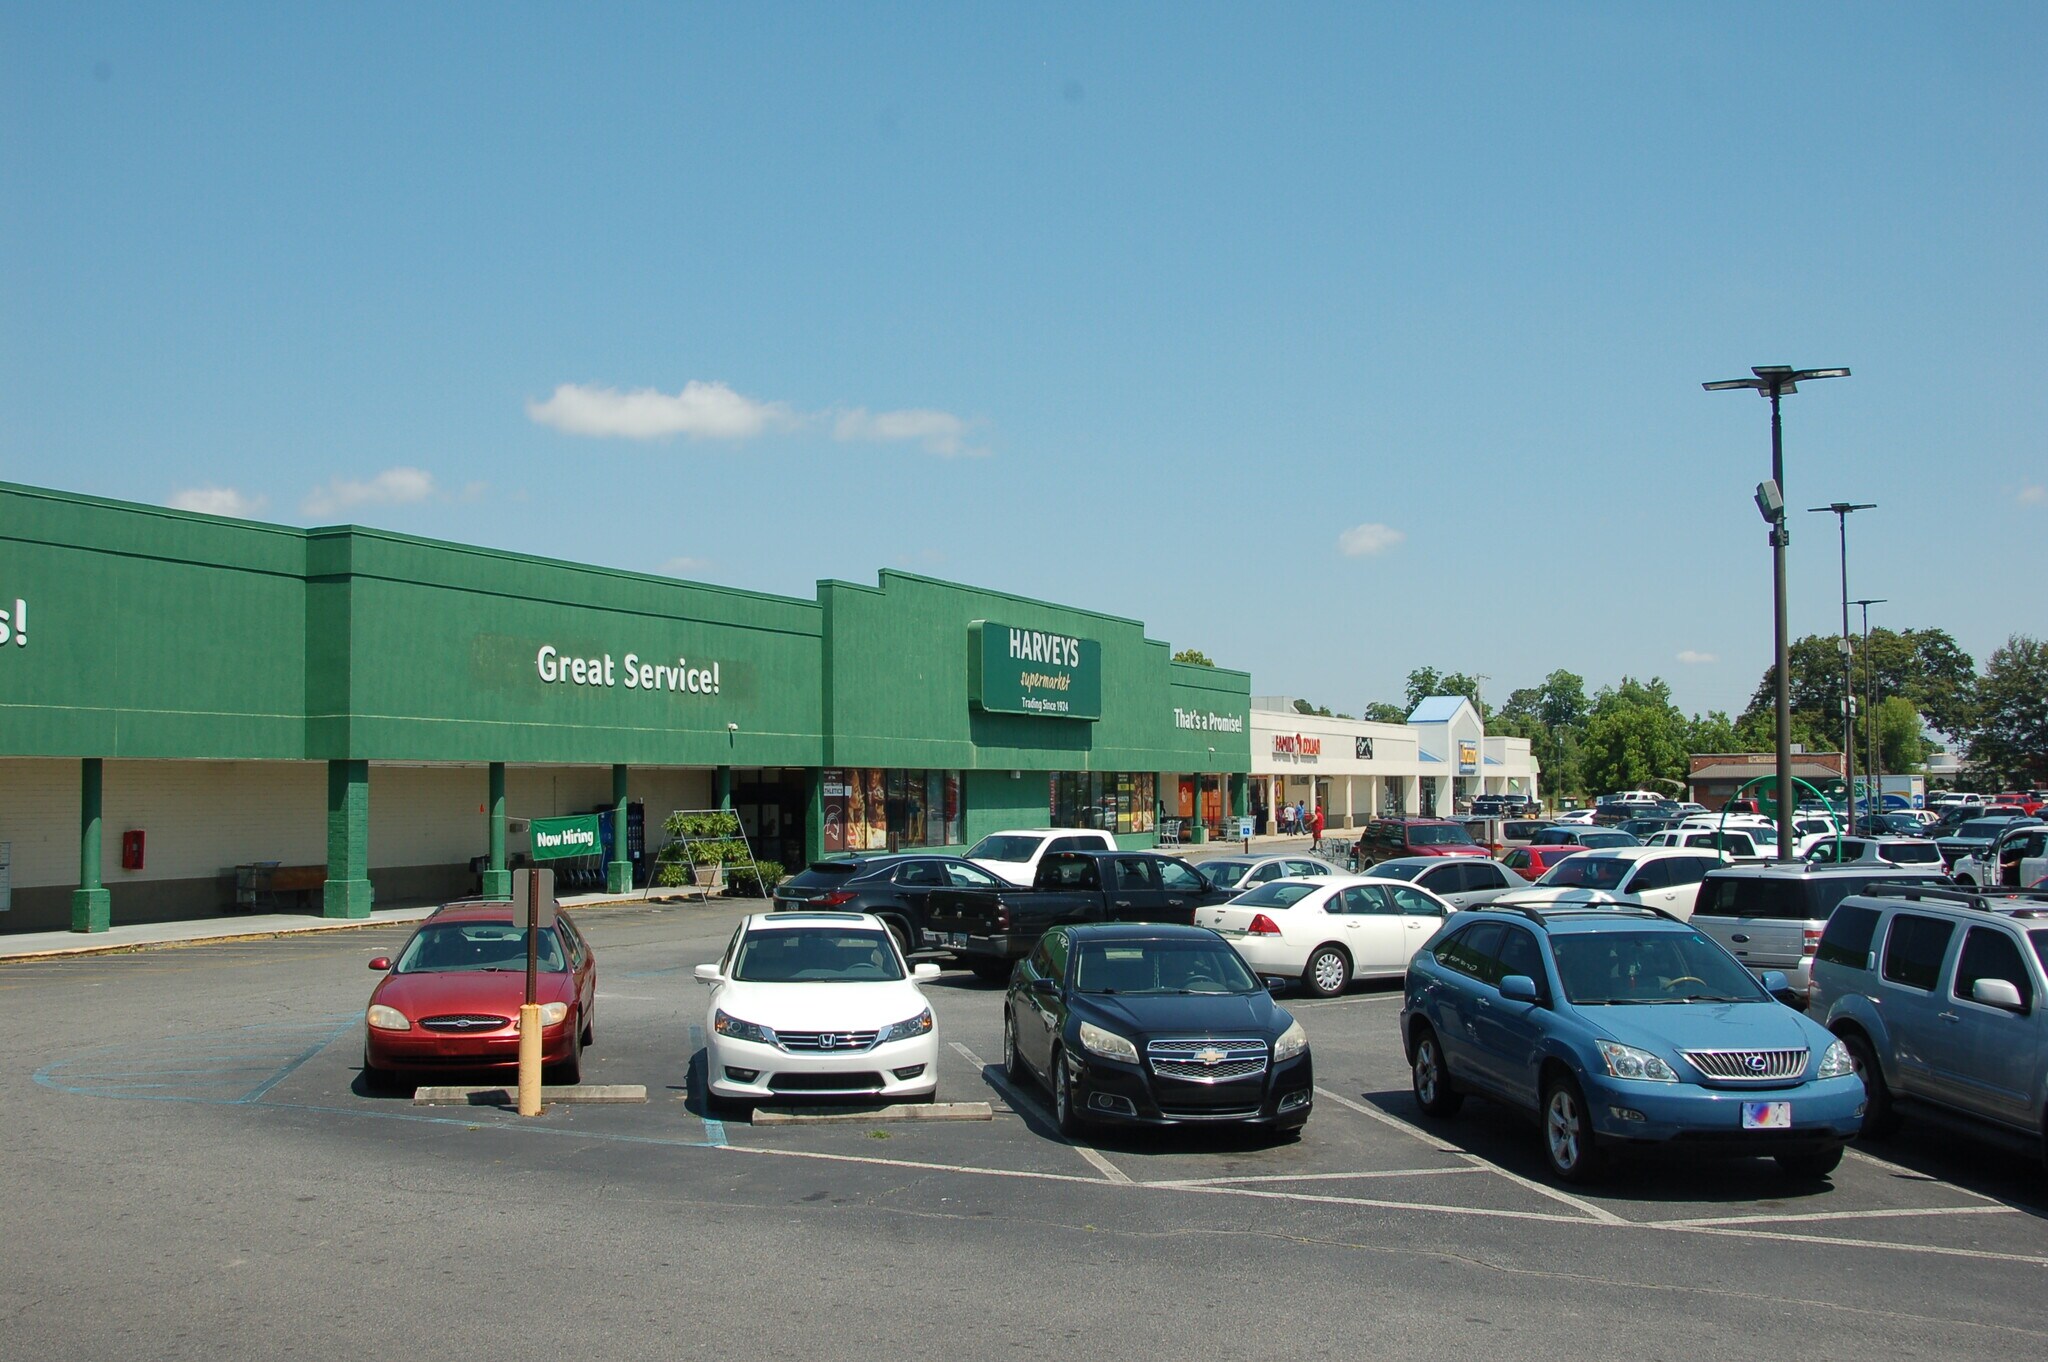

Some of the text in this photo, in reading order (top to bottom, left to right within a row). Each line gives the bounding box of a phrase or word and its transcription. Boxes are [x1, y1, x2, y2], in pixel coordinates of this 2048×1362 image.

[1010, 628, 1079, 668] HARVEYS
[537, 645, 719, 694] Great Service!
[1021, 671, 1070, 693] supermarket
[1022, 697, 1069, 712] Trading Since 1924
[1174, 708, 1242, 733] That's a Promise!
[537, 828, 594, 847] Now Hiring
